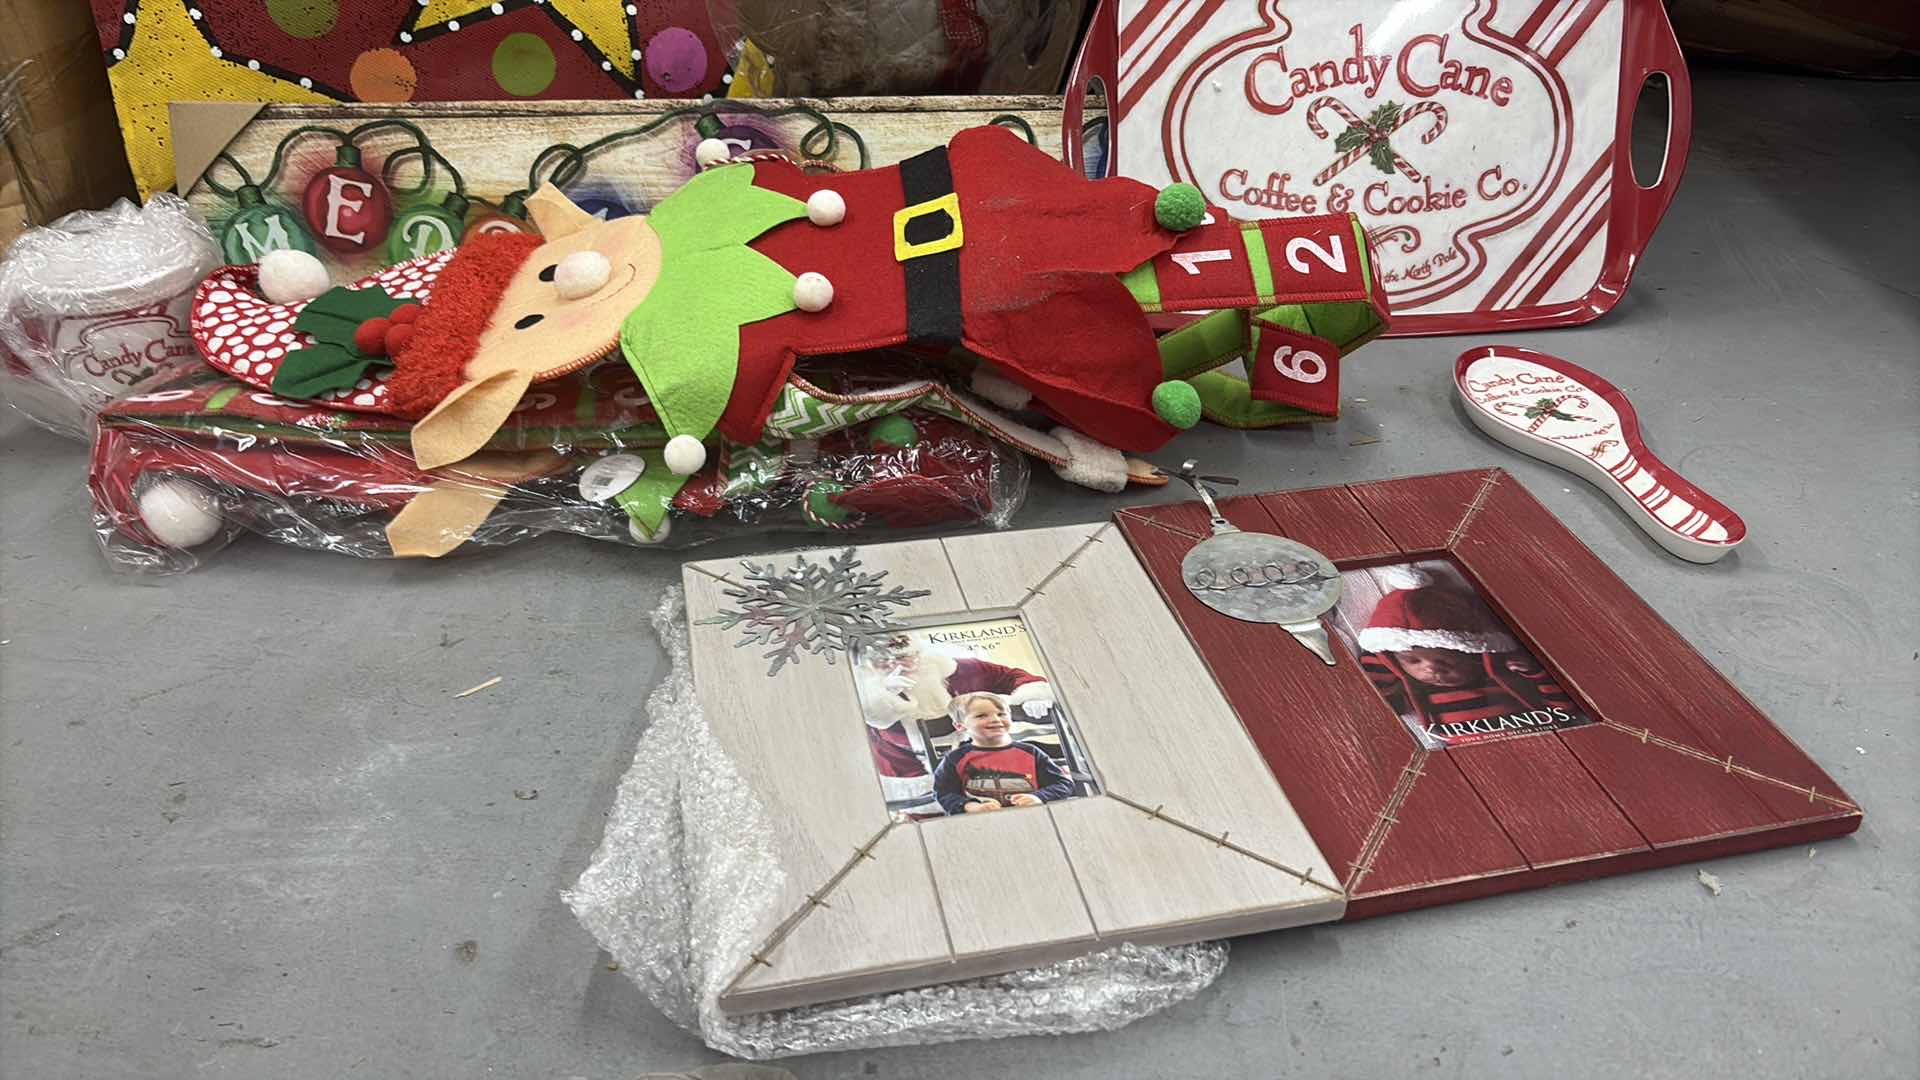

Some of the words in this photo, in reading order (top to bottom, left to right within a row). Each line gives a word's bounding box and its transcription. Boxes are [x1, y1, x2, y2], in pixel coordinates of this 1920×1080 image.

[1244, 23, 1392, 115] Candy
[1397, 33, 1513, 107] Cane
[1219, 168, 1317, 213] Coffee
[1326, 183, 1354, 214] &
[1364, 176, 1467, 215] Cookie
[1477, 165, 1527, 200] Co.
[1285, 235, 1347, 274] 2
[83, 343, 142, 377] Candy
[1468, 374, 1516, 392] Candy
[1516, 372, 1565, 385] Cane
[928, 624, 1026, 644] KIRKLAND'S
[1418, 707, 1570, 743] KIRKLAND'S
